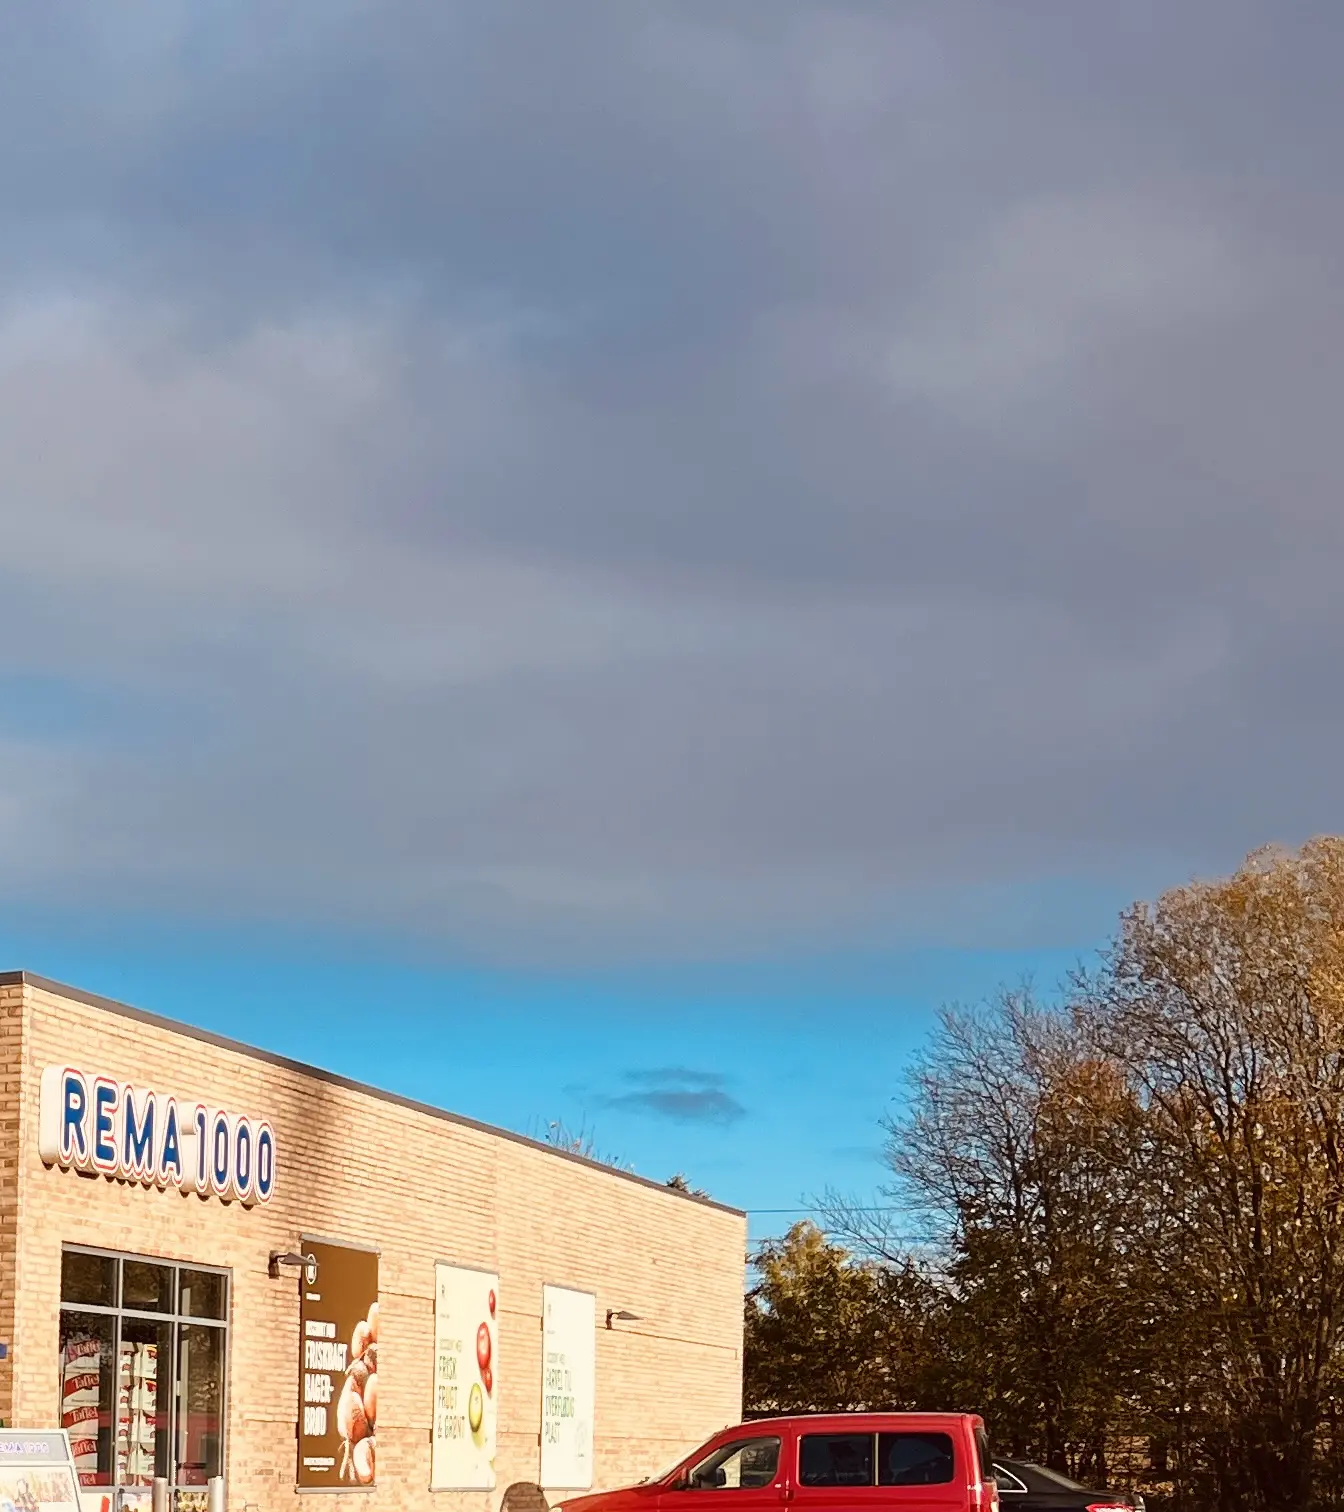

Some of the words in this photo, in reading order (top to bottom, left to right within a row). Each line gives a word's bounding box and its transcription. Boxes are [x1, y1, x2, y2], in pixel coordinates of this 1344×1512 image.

[60, 1067, 183, 1188] REMA
[193, 1103, 276, 1205] 1000
[72, 1406, 99, 1422] Taffel
